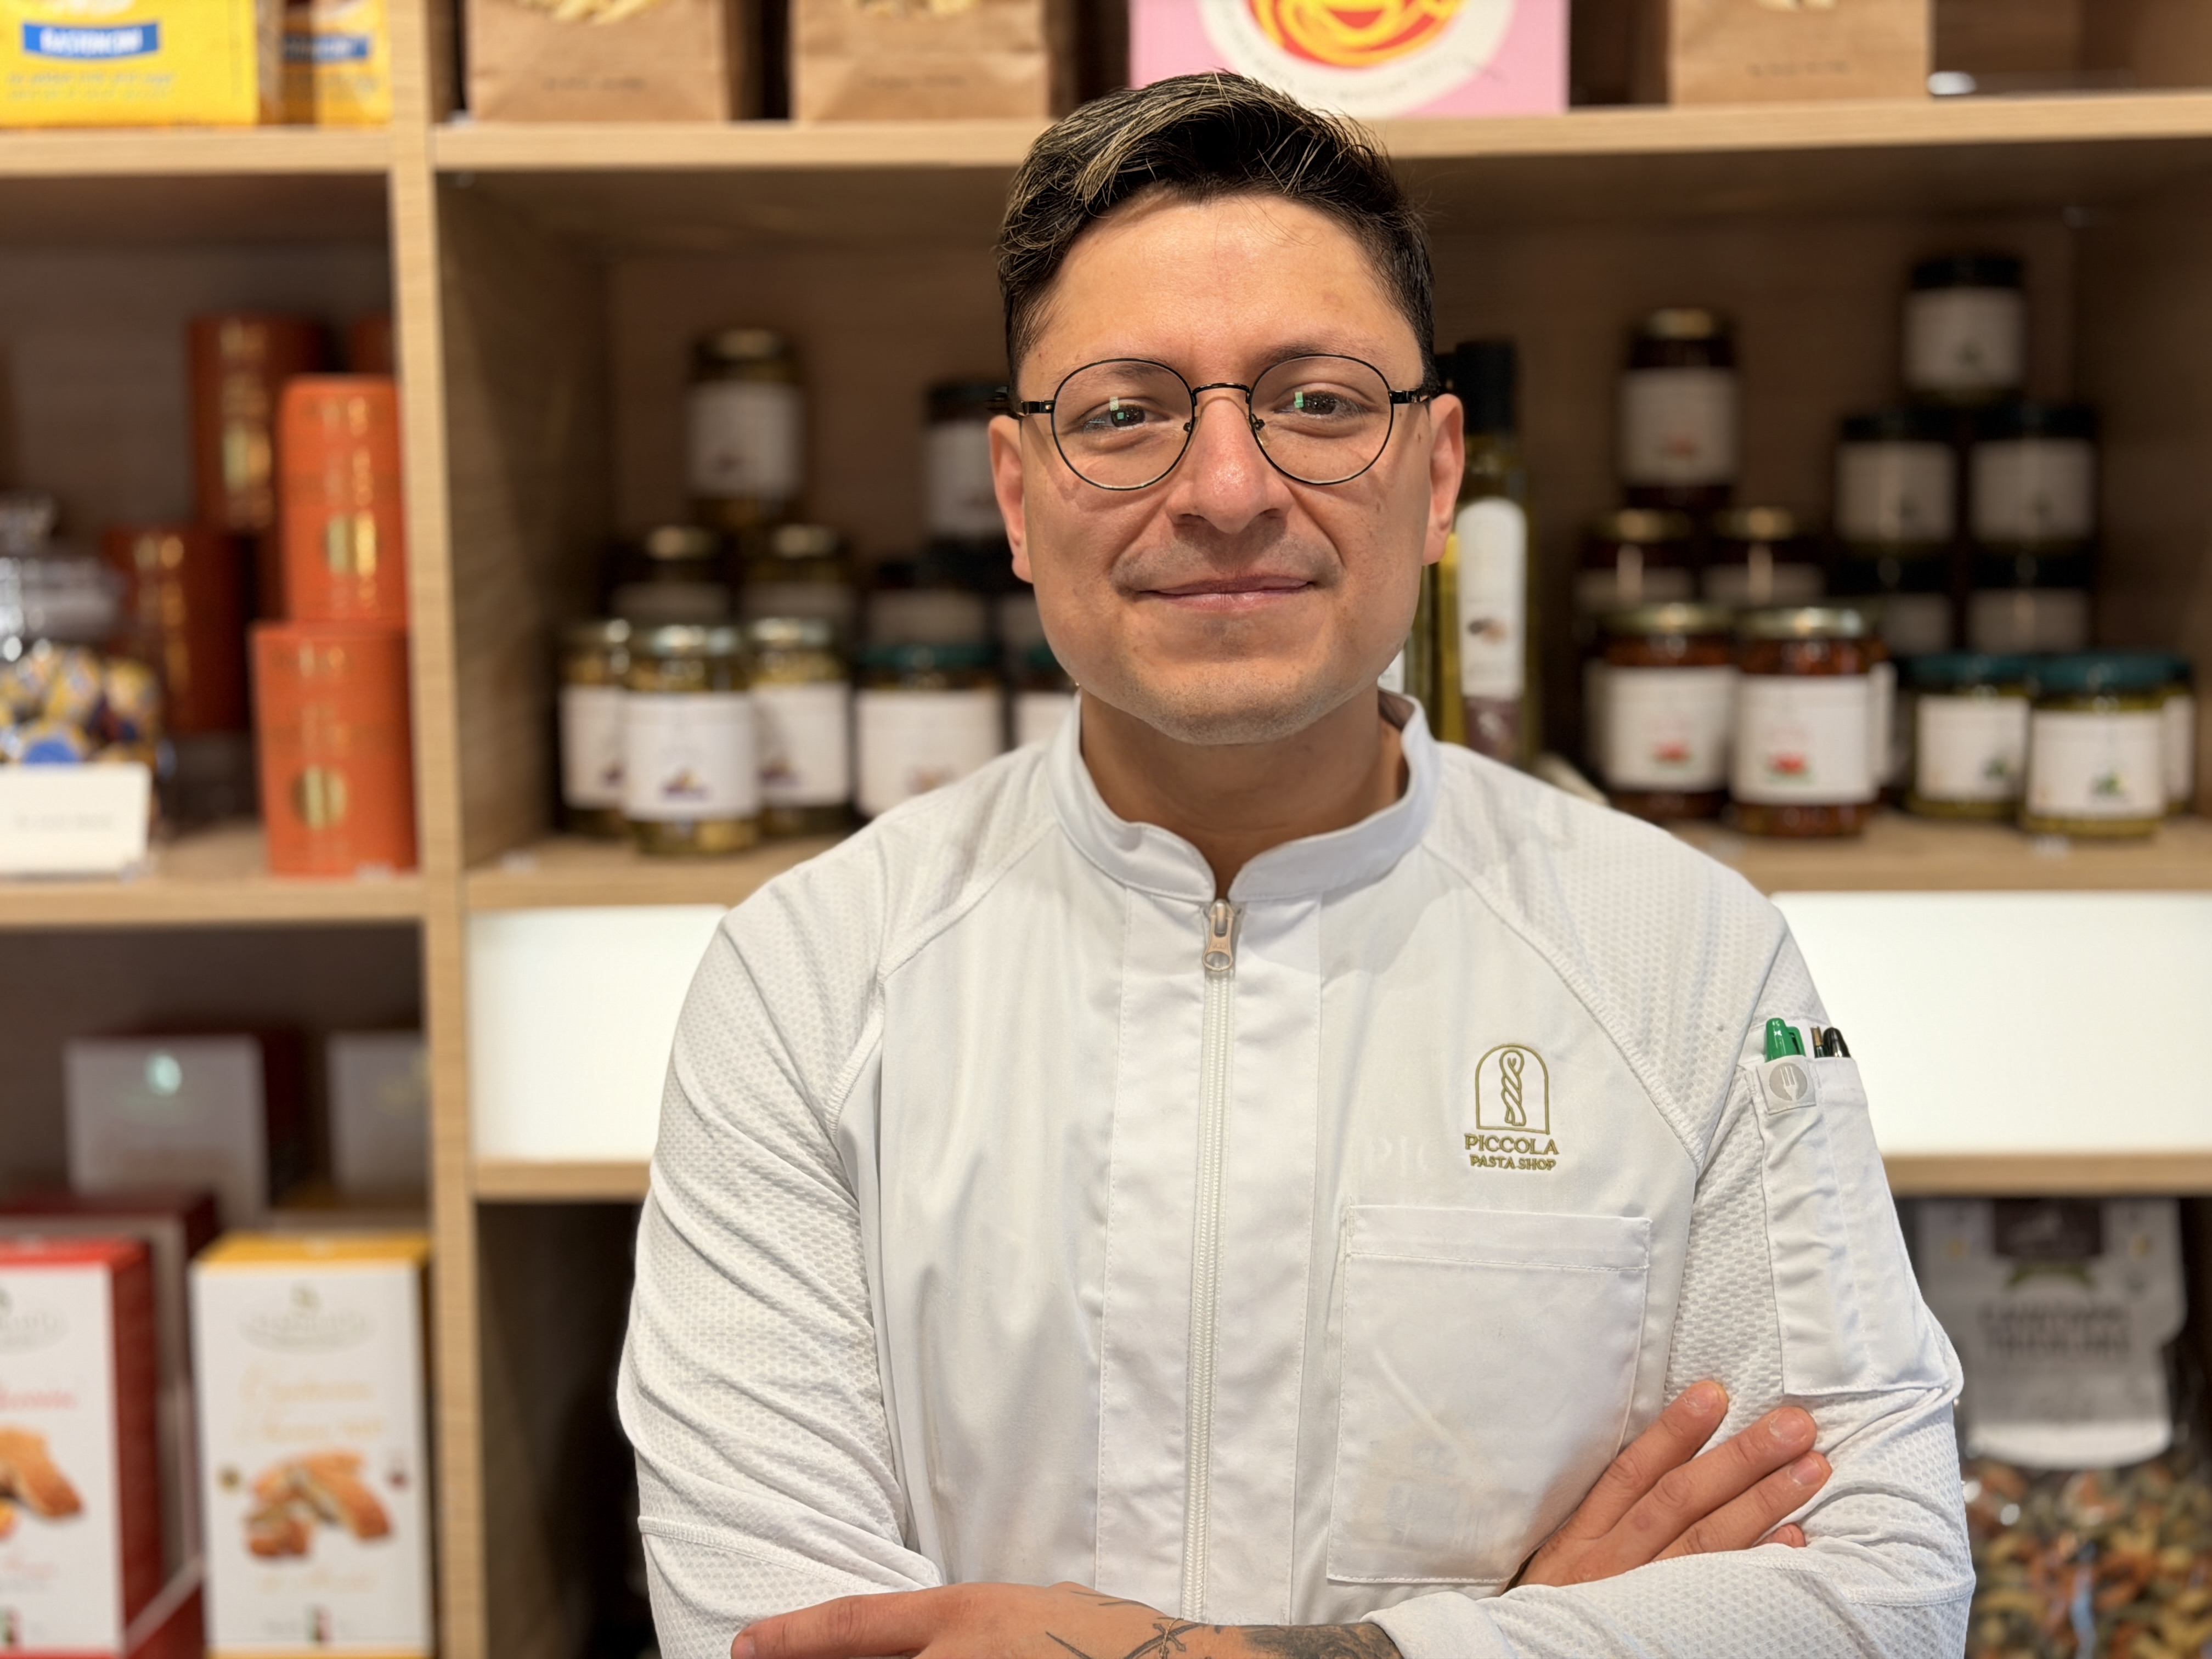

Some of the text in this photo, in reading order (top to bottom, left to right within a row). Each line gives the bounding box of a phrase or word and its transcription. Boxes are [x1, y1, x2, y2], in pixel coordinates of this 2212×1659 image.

[1464, 1133, 1559, 1155] PICCOLA
[1470, 1154, 1556, 1170] PASTA SHOP
